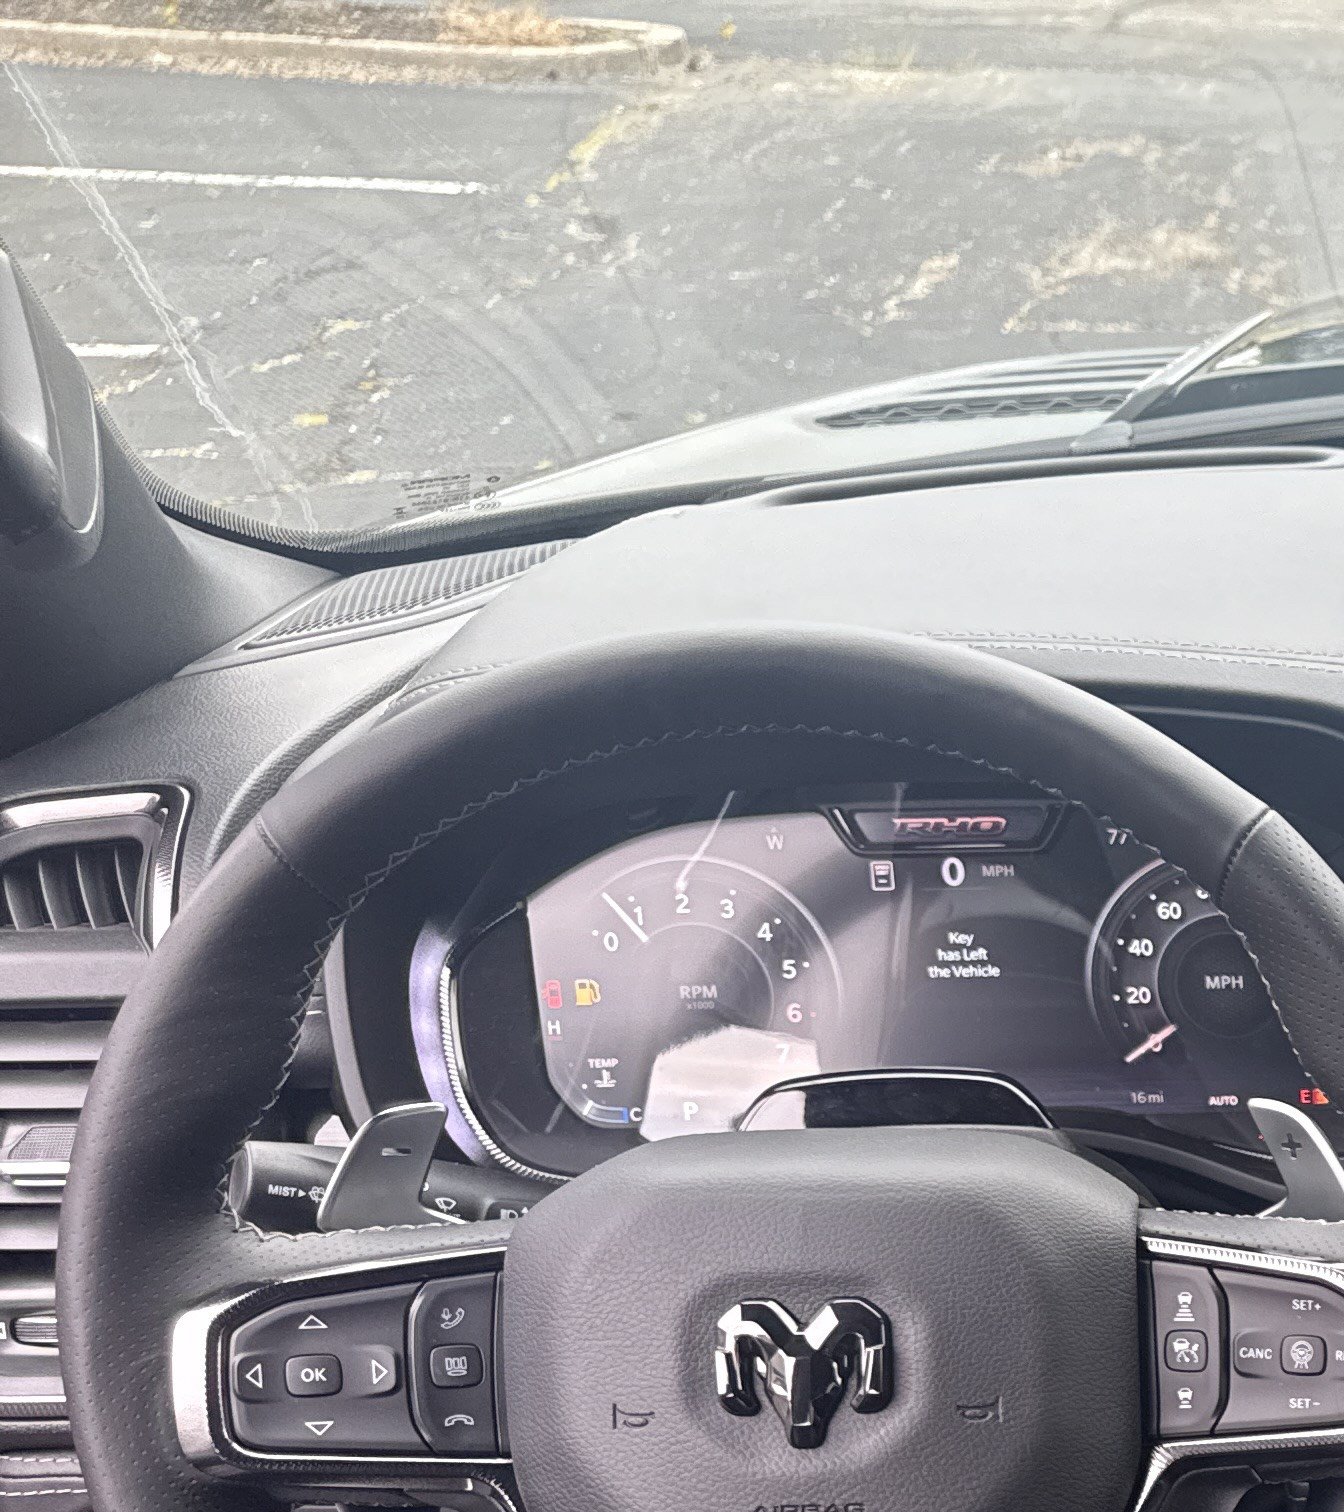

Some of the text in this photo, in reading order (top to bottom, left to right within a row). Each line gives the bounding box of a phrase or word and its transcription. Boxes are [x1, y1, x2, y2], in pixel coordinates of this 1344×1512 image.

[893, 816, 1007, 836] RHO
[765, 833, 784, 850] W
[941, 857, 966, 887] 0
[981, 864, 1015, 879] MPH
[675, 894, 691, 915] 2
[719, 899, 735, 919] 3
[1157, 902, 1182, 920] 60
[633, 906, 645, 926] 1
[756, 922, 774, 942] 4
[948, 931, 975, 947] Key
[603, 931, 619, 953] 0
[1128, 939, 1154, 957] 40
[937, 946, 988, 962] has Left
[781, 960, 797, 979] 5
[928, 964, 1000, 978] the Vehicle
[1204, 975, 1244, 990] MPH
[679, 984, 718, 1000] RPM
[1126, 986, 1151, 1005] 20
[787, 1003, 803, 1023] 6
[546, 1020, 562, 1036] H
[588, 1058, 619, 1069] TEMP
[1130, 1090, 1165, 1104] 16 mi
[1208, 1095, 1239, 1106] AUTO
[629, 1107, 643, 1122] C
[683, 1101, 699, 1121] P
[268, 1184, 297, 1197] MIST
[1239, 1346, 1273, 1360] CANC
[300, 1367, 327, 1382] OK
